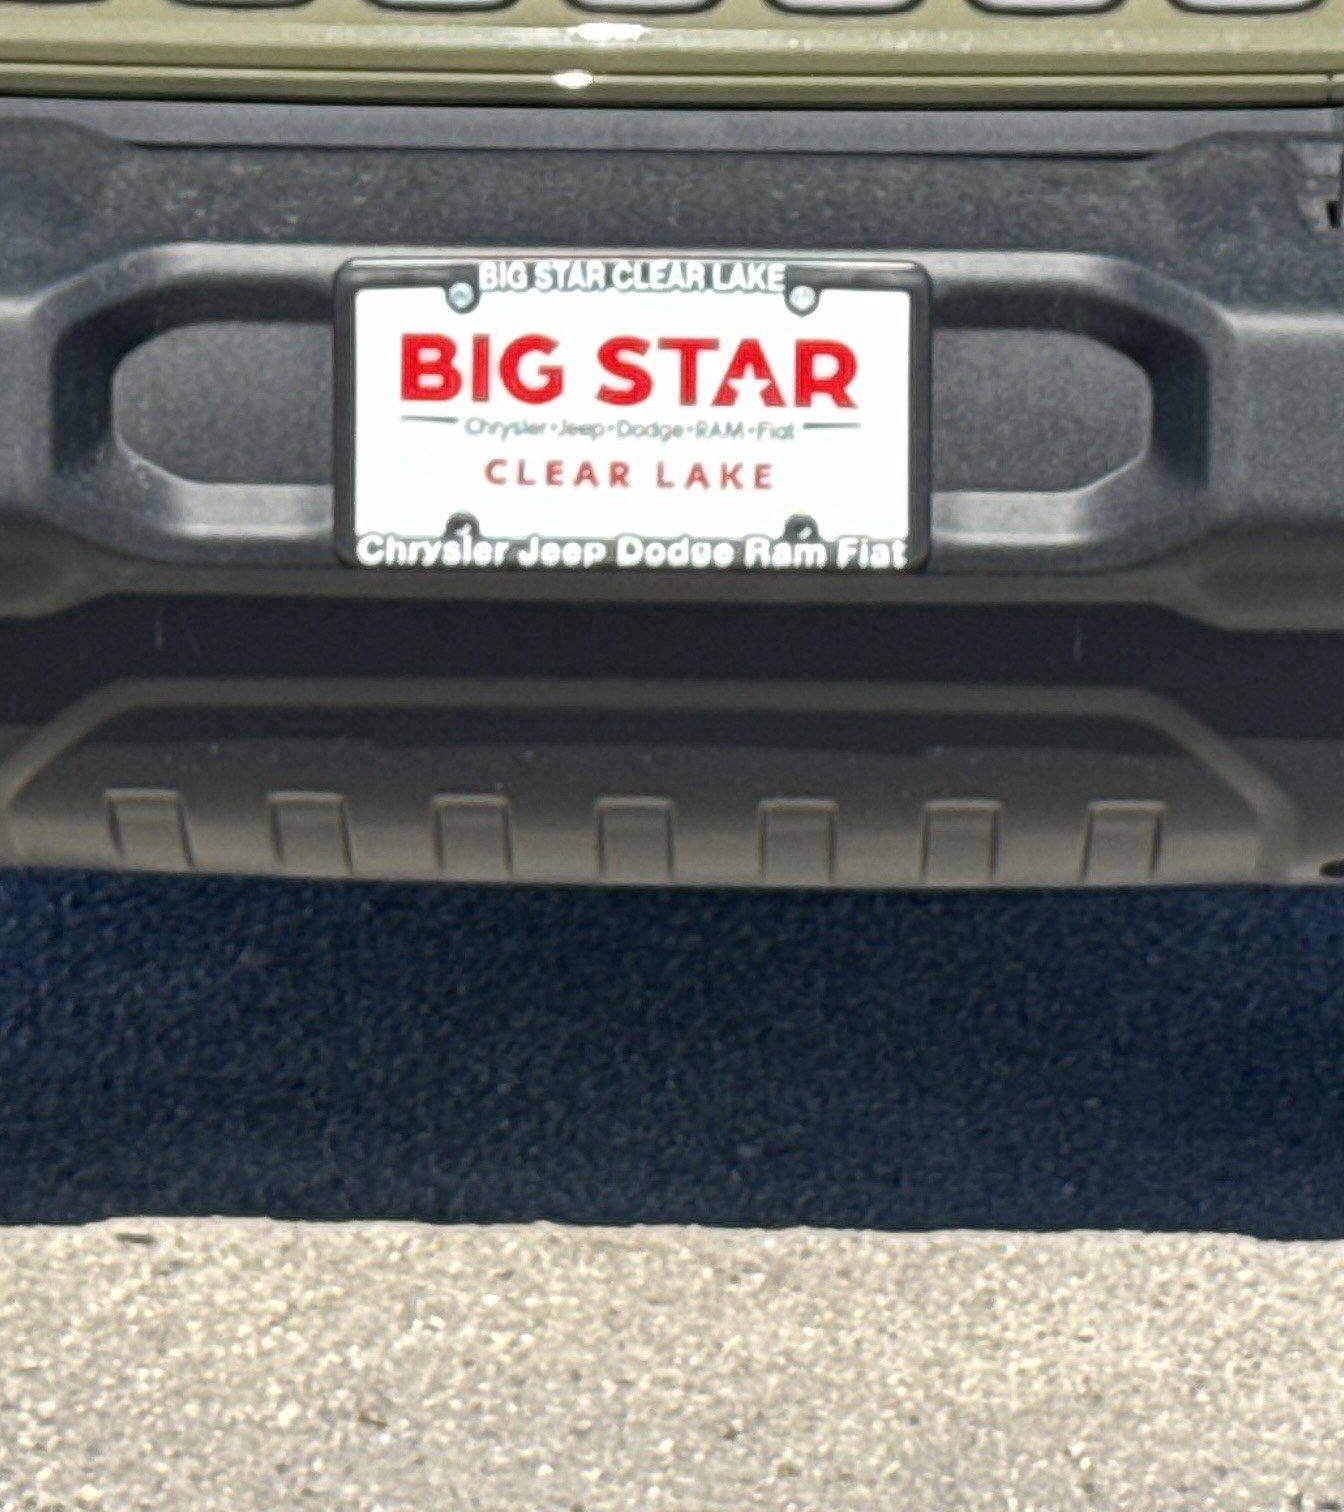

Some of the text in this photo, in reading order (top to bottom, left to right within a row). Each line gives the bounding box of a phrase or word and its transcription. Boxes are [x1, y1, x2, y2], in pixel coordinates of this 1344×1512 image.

[479, 261, 785, 291] BIG STAR CLEAR LAKE
[400, 334, 858, 408] BIG STAR
[484, 458, 773, 490] CLEAR LAKE
[356, 534, 908, 570] Chrysler Jeep Dodge Ram Fiat
